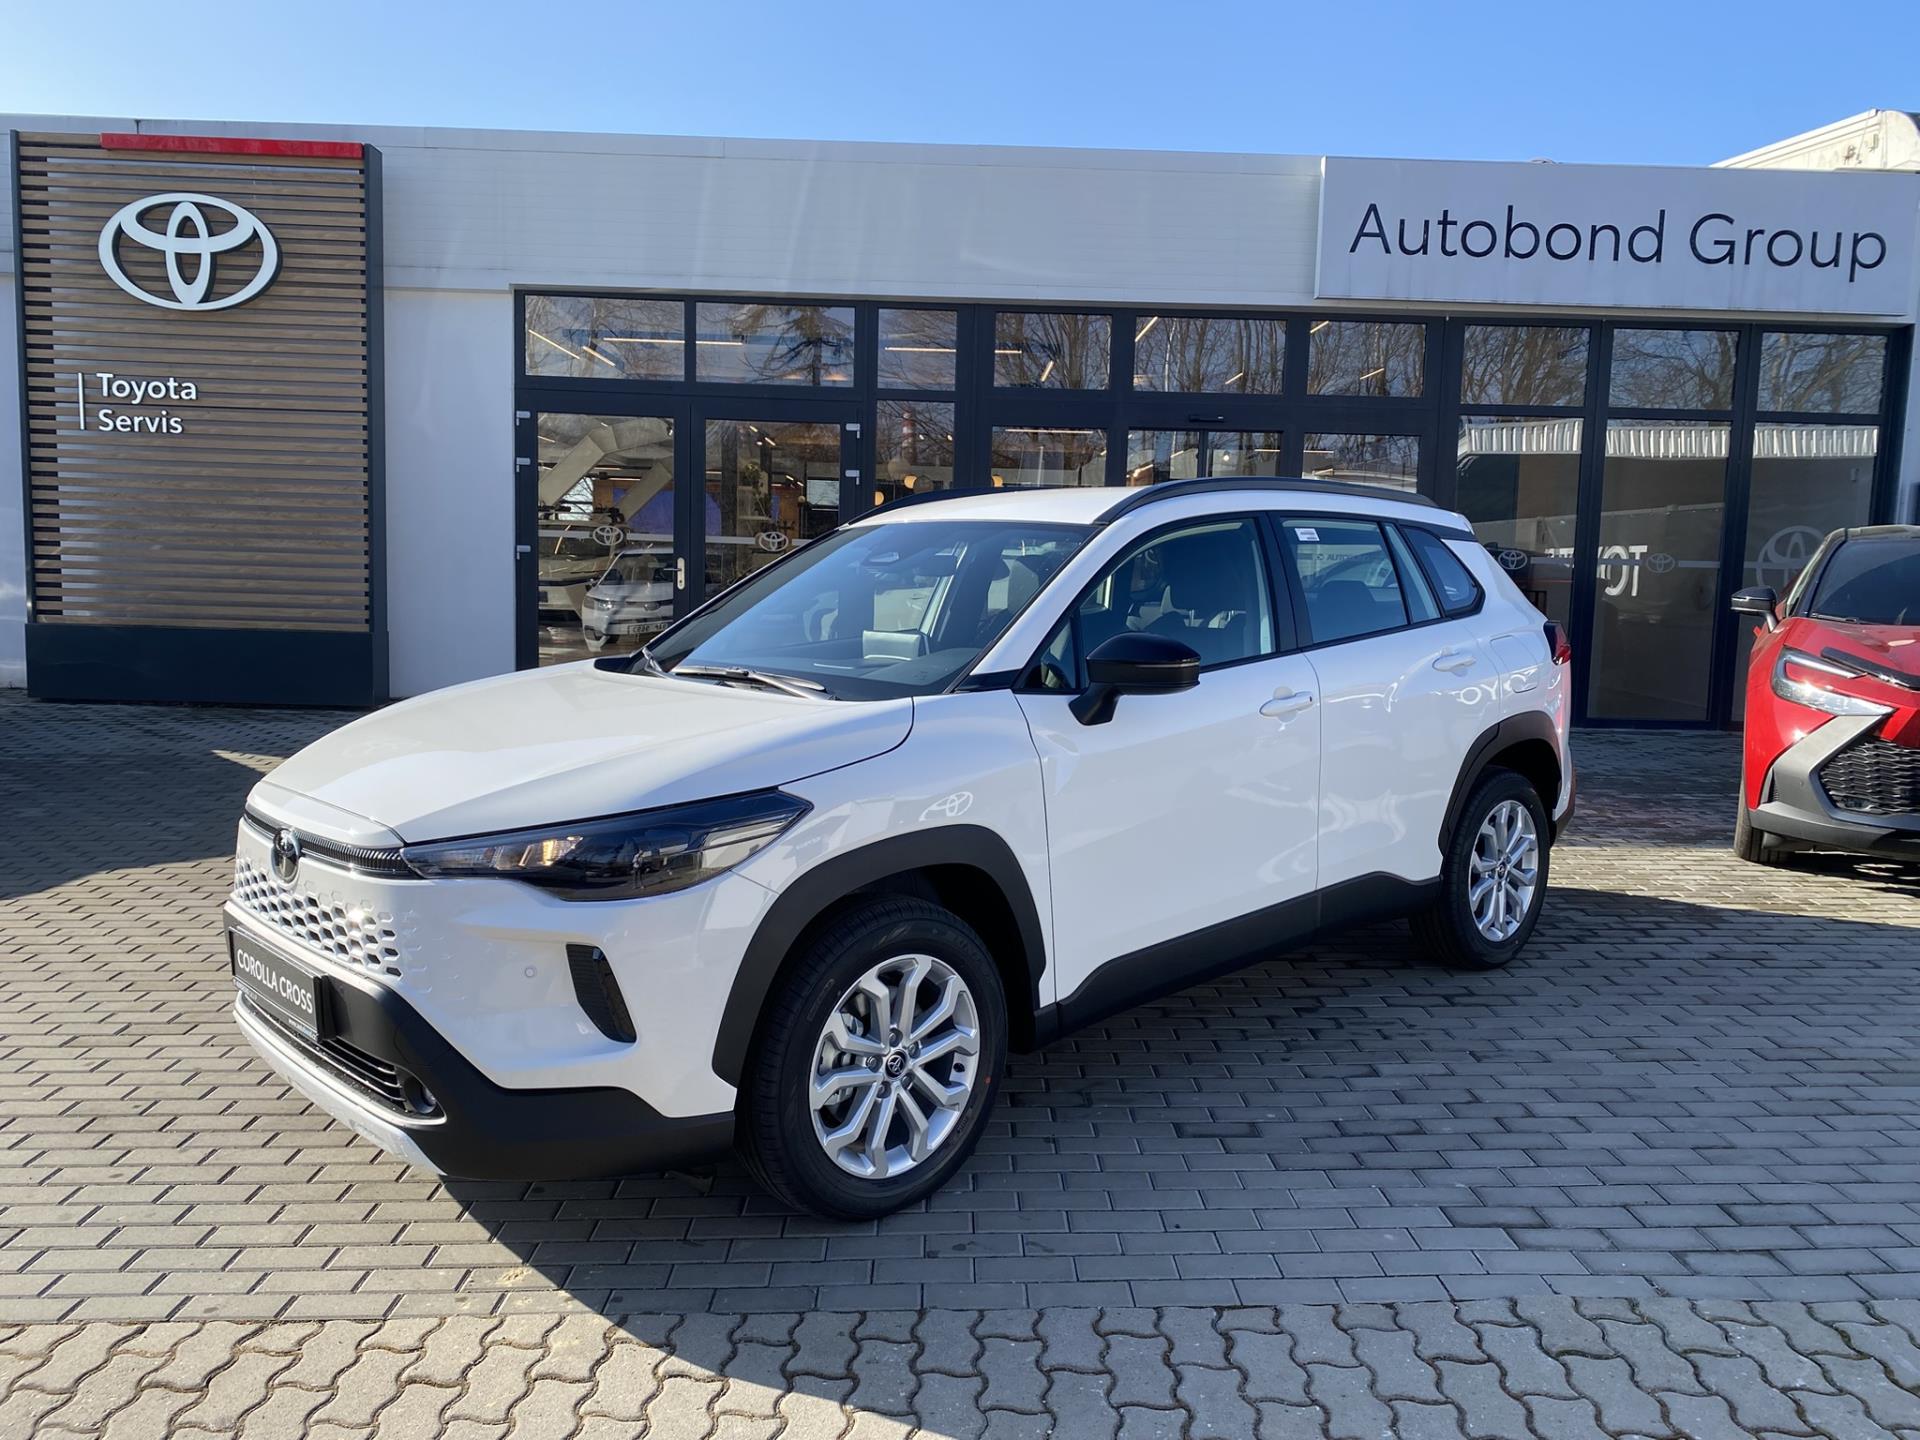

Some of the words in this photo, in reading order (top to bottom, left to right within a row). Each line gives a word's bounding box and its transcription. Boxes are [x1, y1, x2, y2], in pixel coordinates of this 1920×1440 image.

[1348, 203, 1665, 263] Autobond
[1689, 212, 1887, 282] Group
[96, 372, 198, 404] Toyota
[98, 408, 184, 433] Servis
[237, 949, 279, 993] COROLLA
[279, 976, 313, 1014] CROSS
